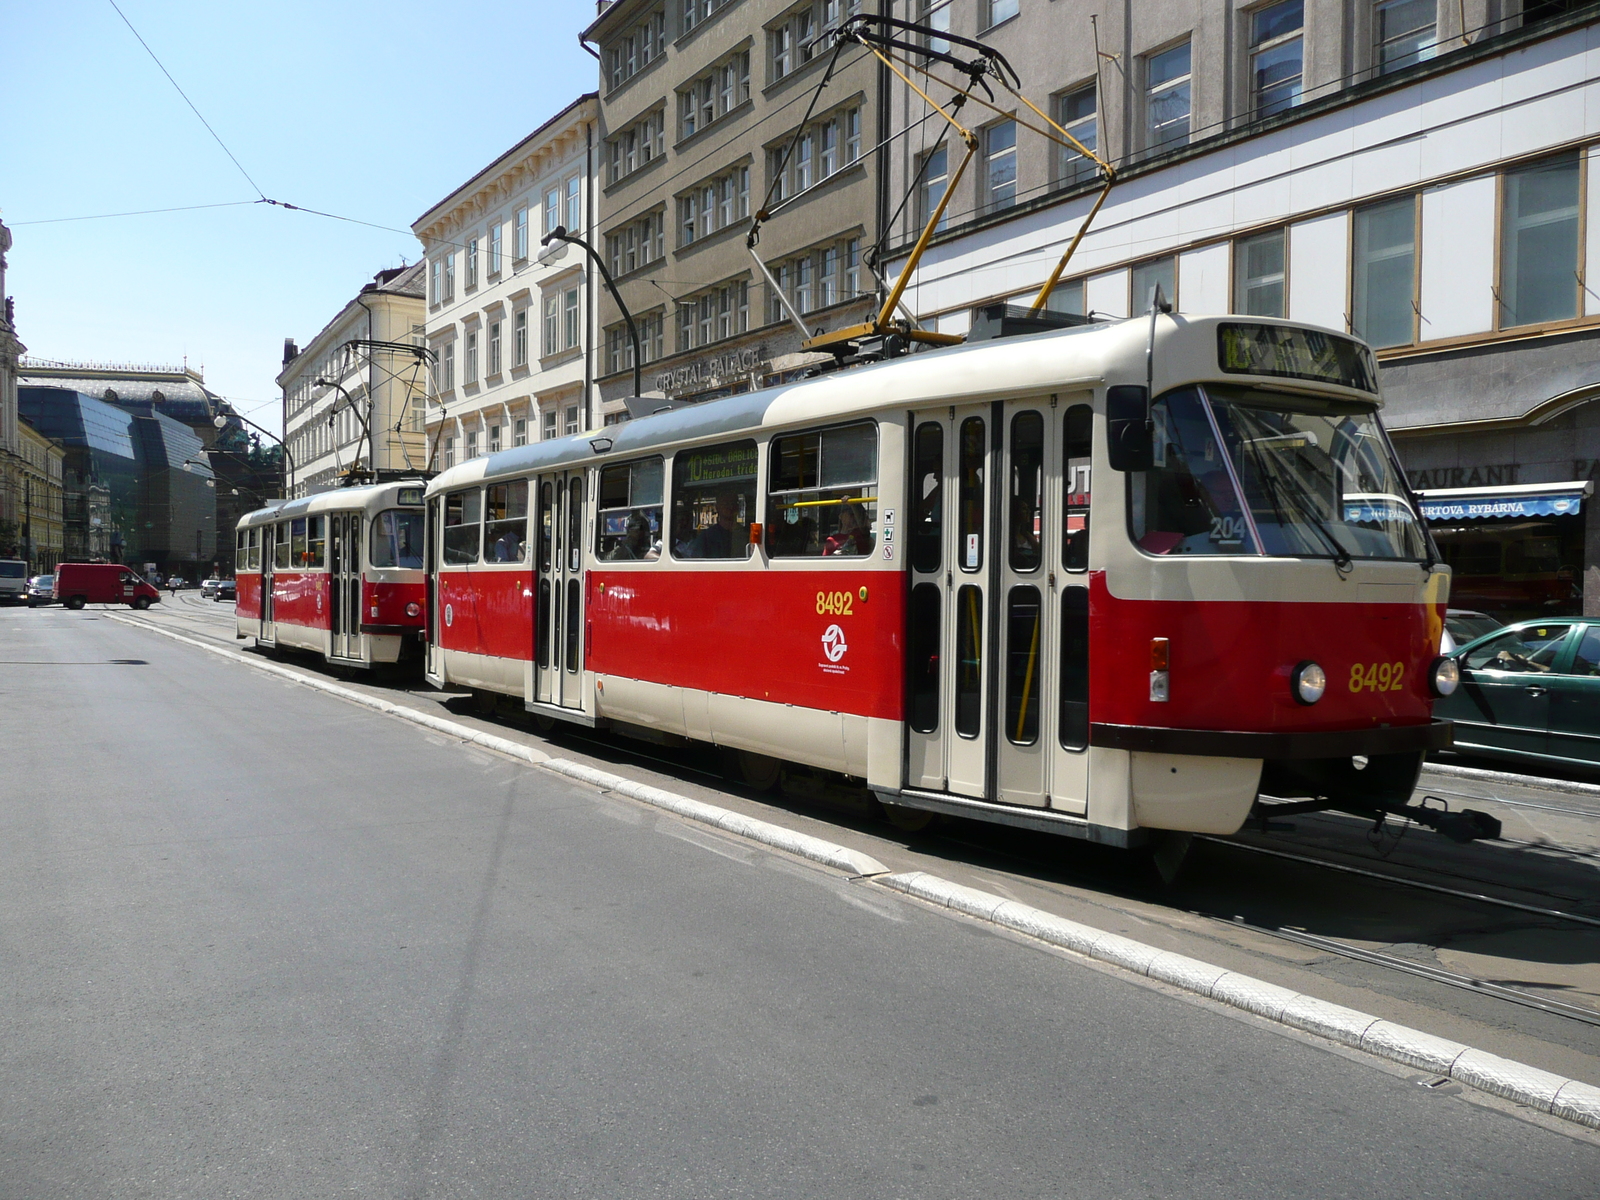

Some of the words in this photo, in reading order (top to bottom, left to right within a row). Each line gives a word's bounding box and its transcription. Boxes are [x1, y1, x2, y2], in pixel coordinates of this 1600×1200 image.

[655, 363, 702, 391] CRYSTAL
[709, 348, 760, 378] PALACE
[687, 454, 702, 482] 10
[402, 489, 419, 504] 10
[1468, 501, 1525, 514] RYBÁRNA
[1210, 516, 1246, 539] 204
[816, 591, 853, 615] 8492
[1348, 661, 1404, 693] 8492
